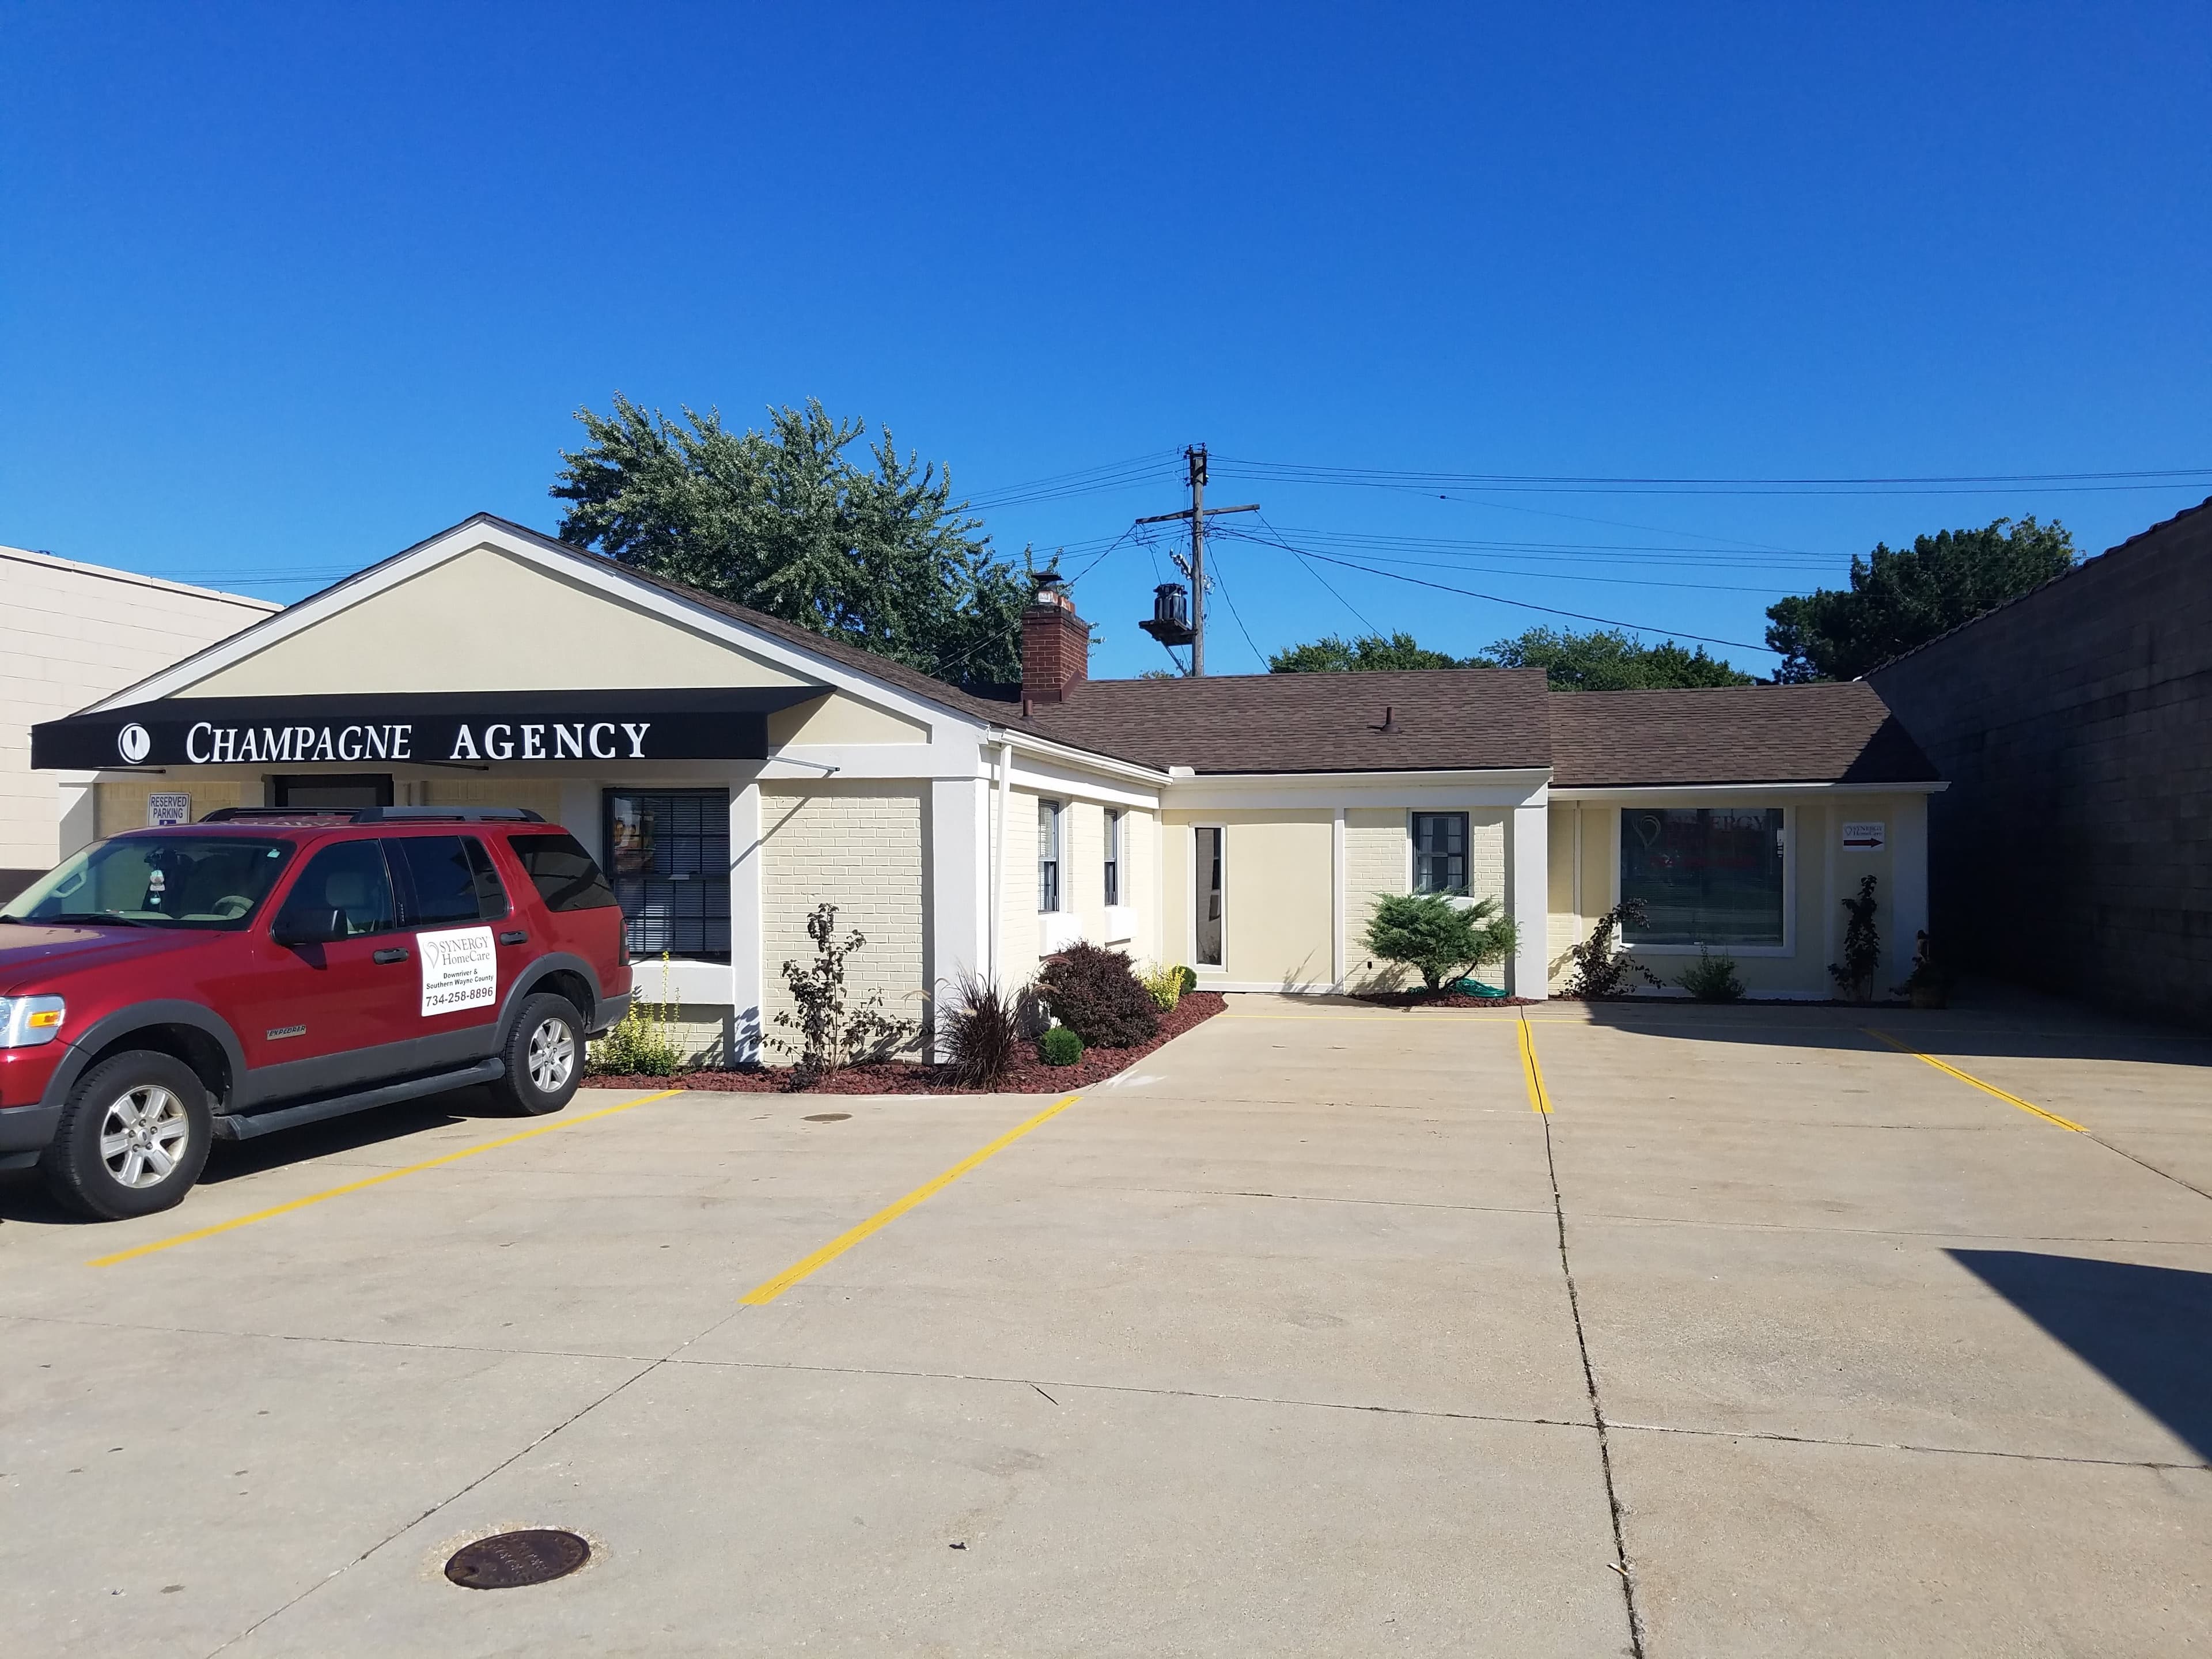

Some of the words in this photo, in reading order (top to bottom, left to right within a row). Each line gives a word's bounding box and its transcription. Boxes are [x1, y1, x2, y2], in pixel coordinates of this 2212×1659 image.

[186, 722, 412, 763] CHAMPAGNE
[450, 723, 651, 759] AGENCY
[151, 796, 187, 807] RESERVED
[153, 808, 183, 819] PARKING
[440, 936, 488, 953] SYNERGY
[442, 950, 490, 965] HomeCare
[426, 981, 453, 990] Southern
[454, 978, 474, 986] Wayne
[475, 974, 494, 983] County
[444, 970, 472, 979] Downriver
[426, 986, 494, 1007] 734-258-8896
[269, 1025, 306, 1037] EXPLORER
